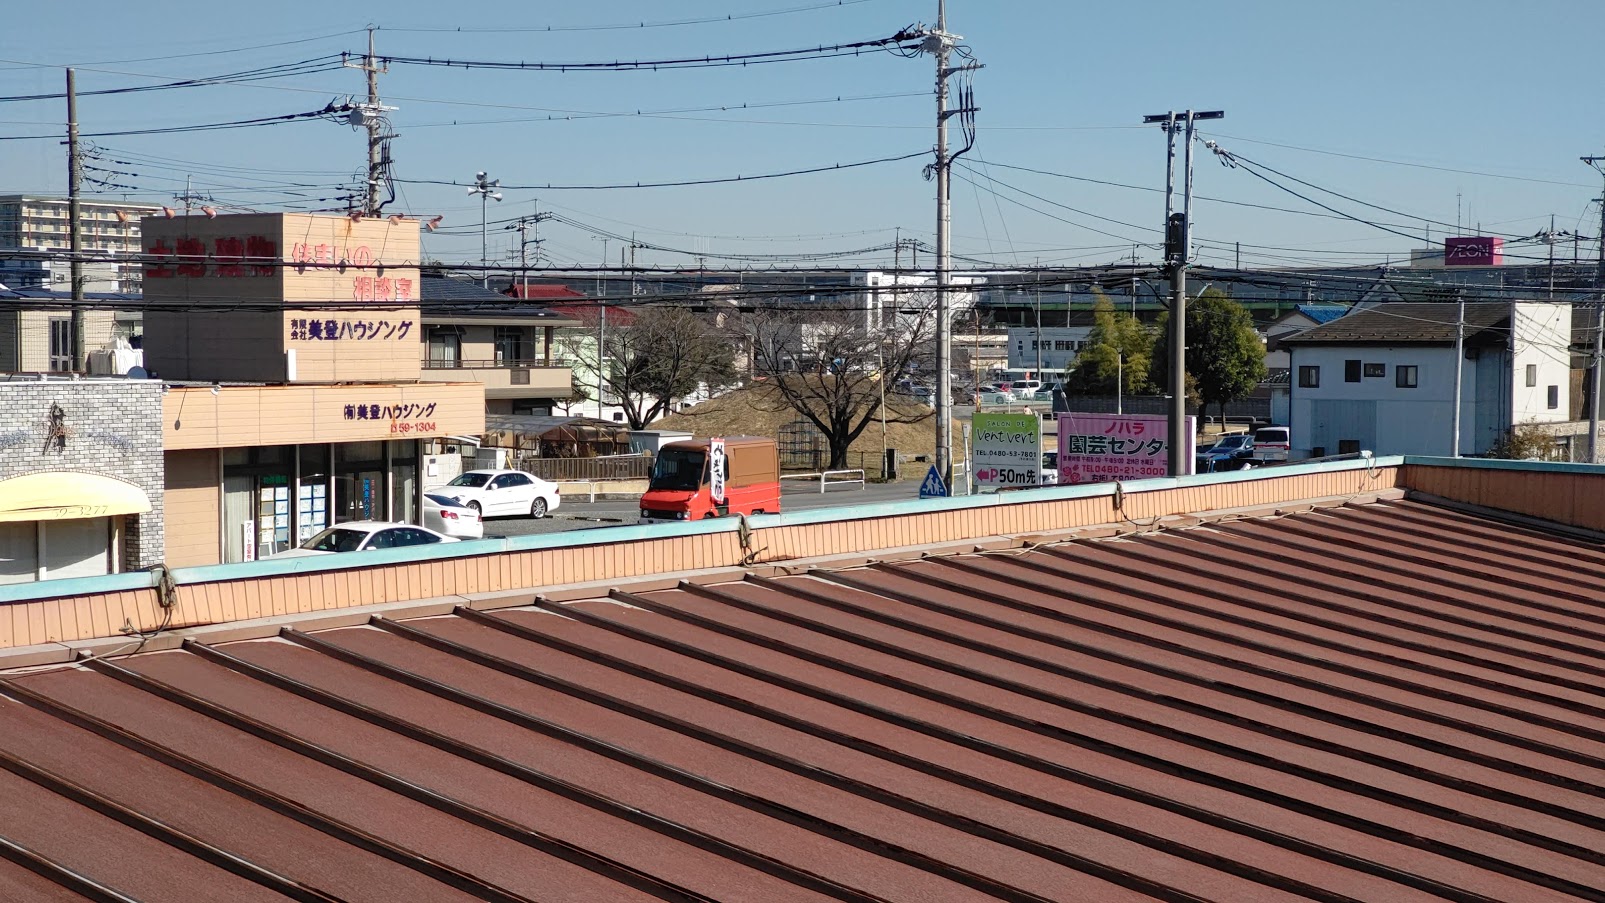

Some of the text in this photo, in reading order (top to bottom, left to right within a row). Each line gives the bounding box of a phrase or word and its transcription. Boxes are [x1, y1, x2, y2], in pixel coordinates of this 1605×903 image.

[291, 242, 372, 272] 住まいの
[353, 276, 413, 301] 相談室
[290, 319, 307, 330] 有限
[308, 319, 413, 340] 美登ハウジング
[290, 330, 307, 340] 会社
[398, 422, 437, 433] 59-1304
[1104, 421, 1145, 435] ノハラ
[976, 428, 1005, 443] Vent
[1091, 473, 1142, 482] 右折して800
